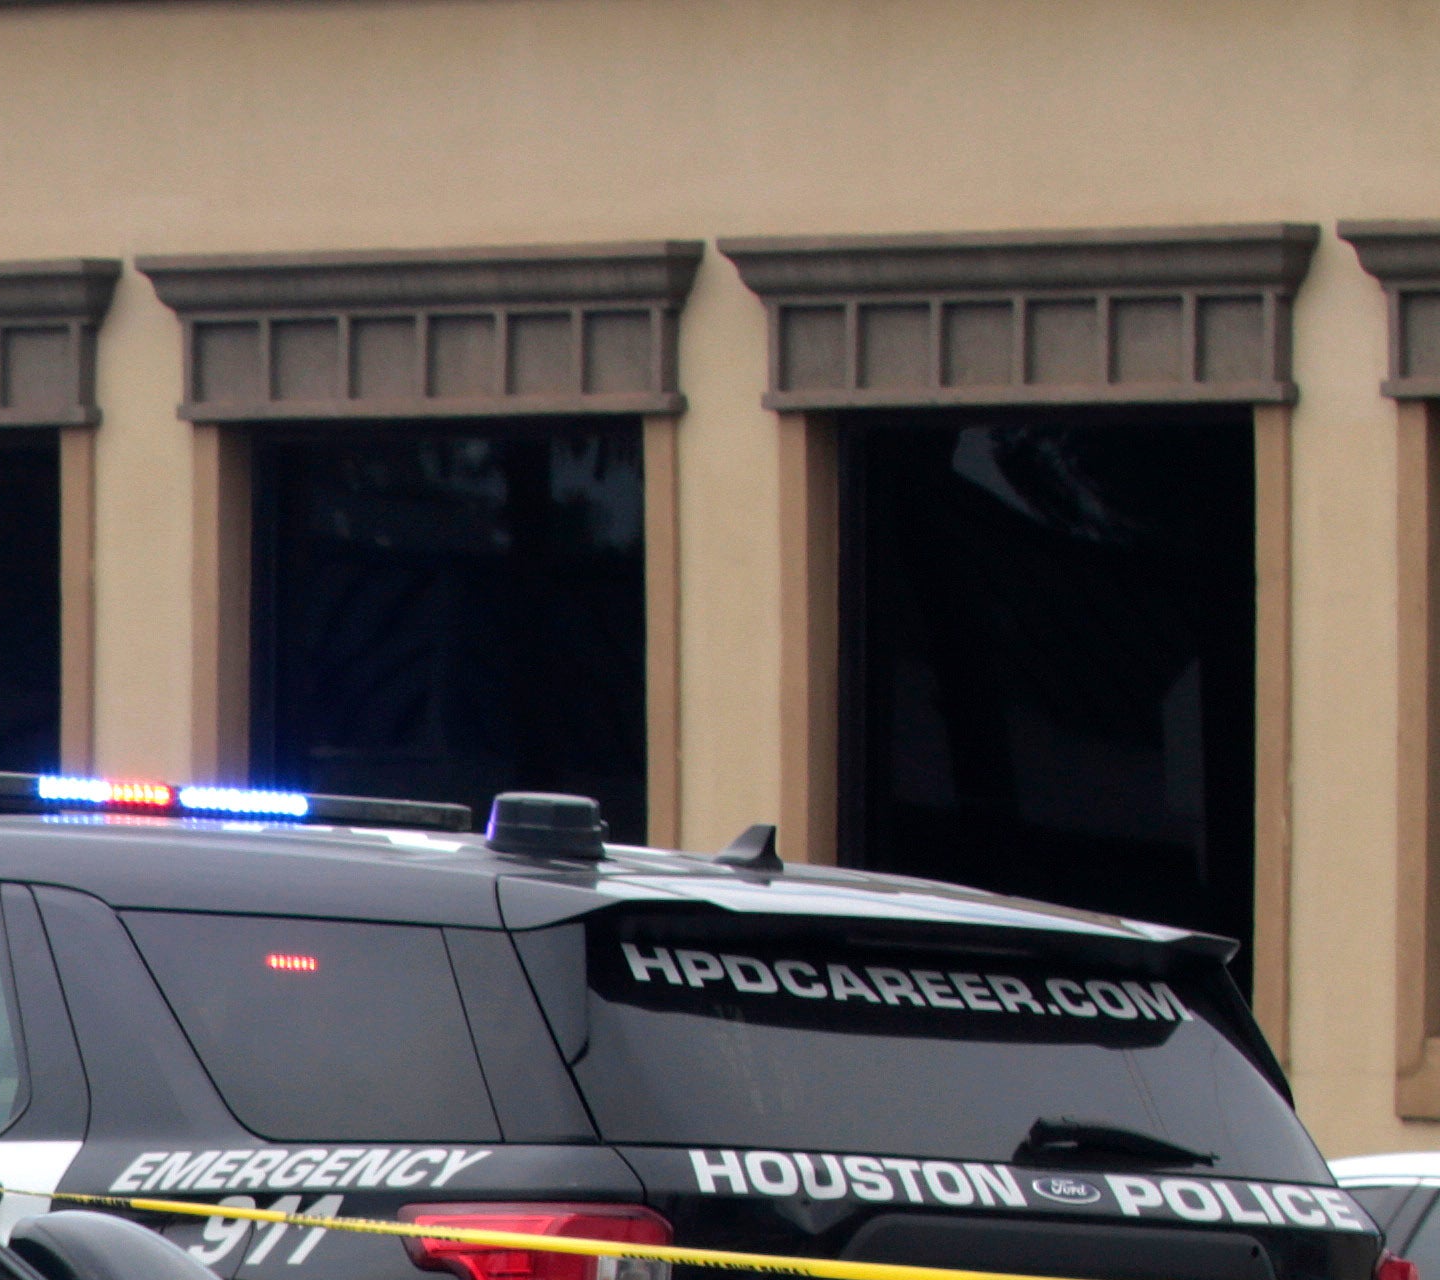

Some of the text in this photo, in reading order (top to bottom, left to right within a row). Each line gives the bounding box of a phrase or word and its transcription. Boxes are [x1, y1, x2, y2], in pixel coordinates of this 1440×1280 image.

[621, 942, 1194, 1022] HPDCAREER.COM
[109, 1148, 493, 1193] EMERGENCY
[689, 1148, 1027, 1207] HOUSTON
[1104, 1173, 1364, 1232] POLICE
[188, 1194, 344, 1265] 911
